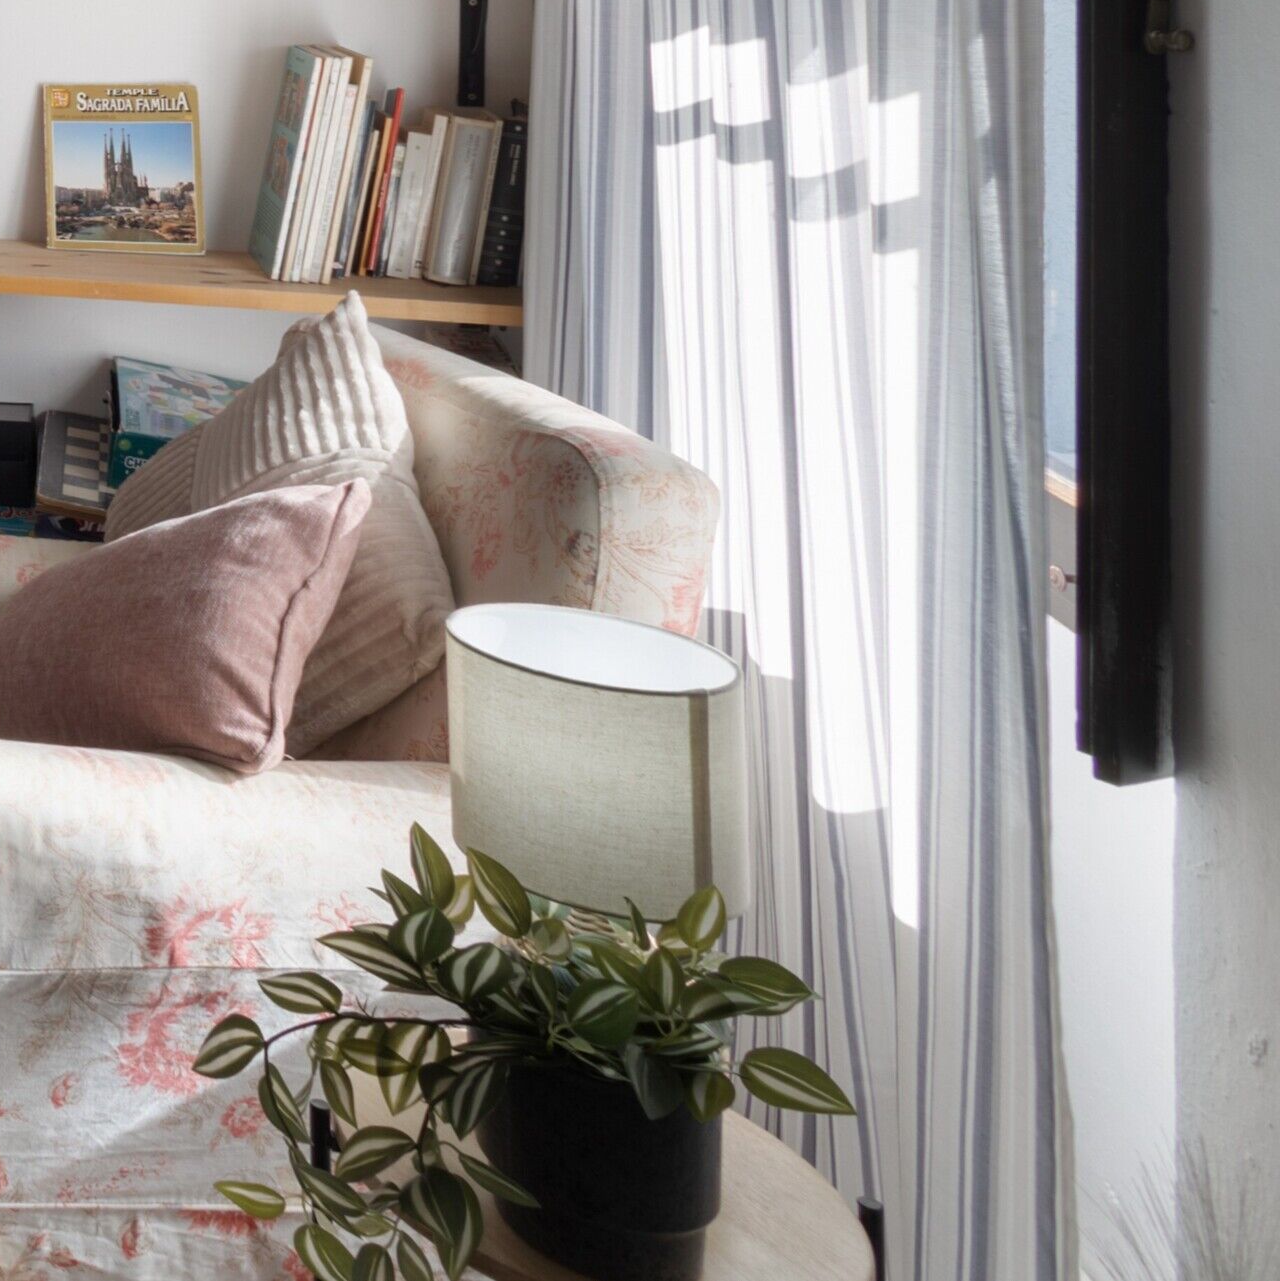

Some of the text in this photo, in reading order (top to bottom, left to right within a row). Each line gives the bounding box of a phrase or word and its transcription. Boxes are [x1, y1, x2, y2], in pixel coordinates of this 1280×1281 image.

[106, 88, 159, 96] TEMPLE
[76, 91, 190, 111] SAGRADA FAMÍLIA
